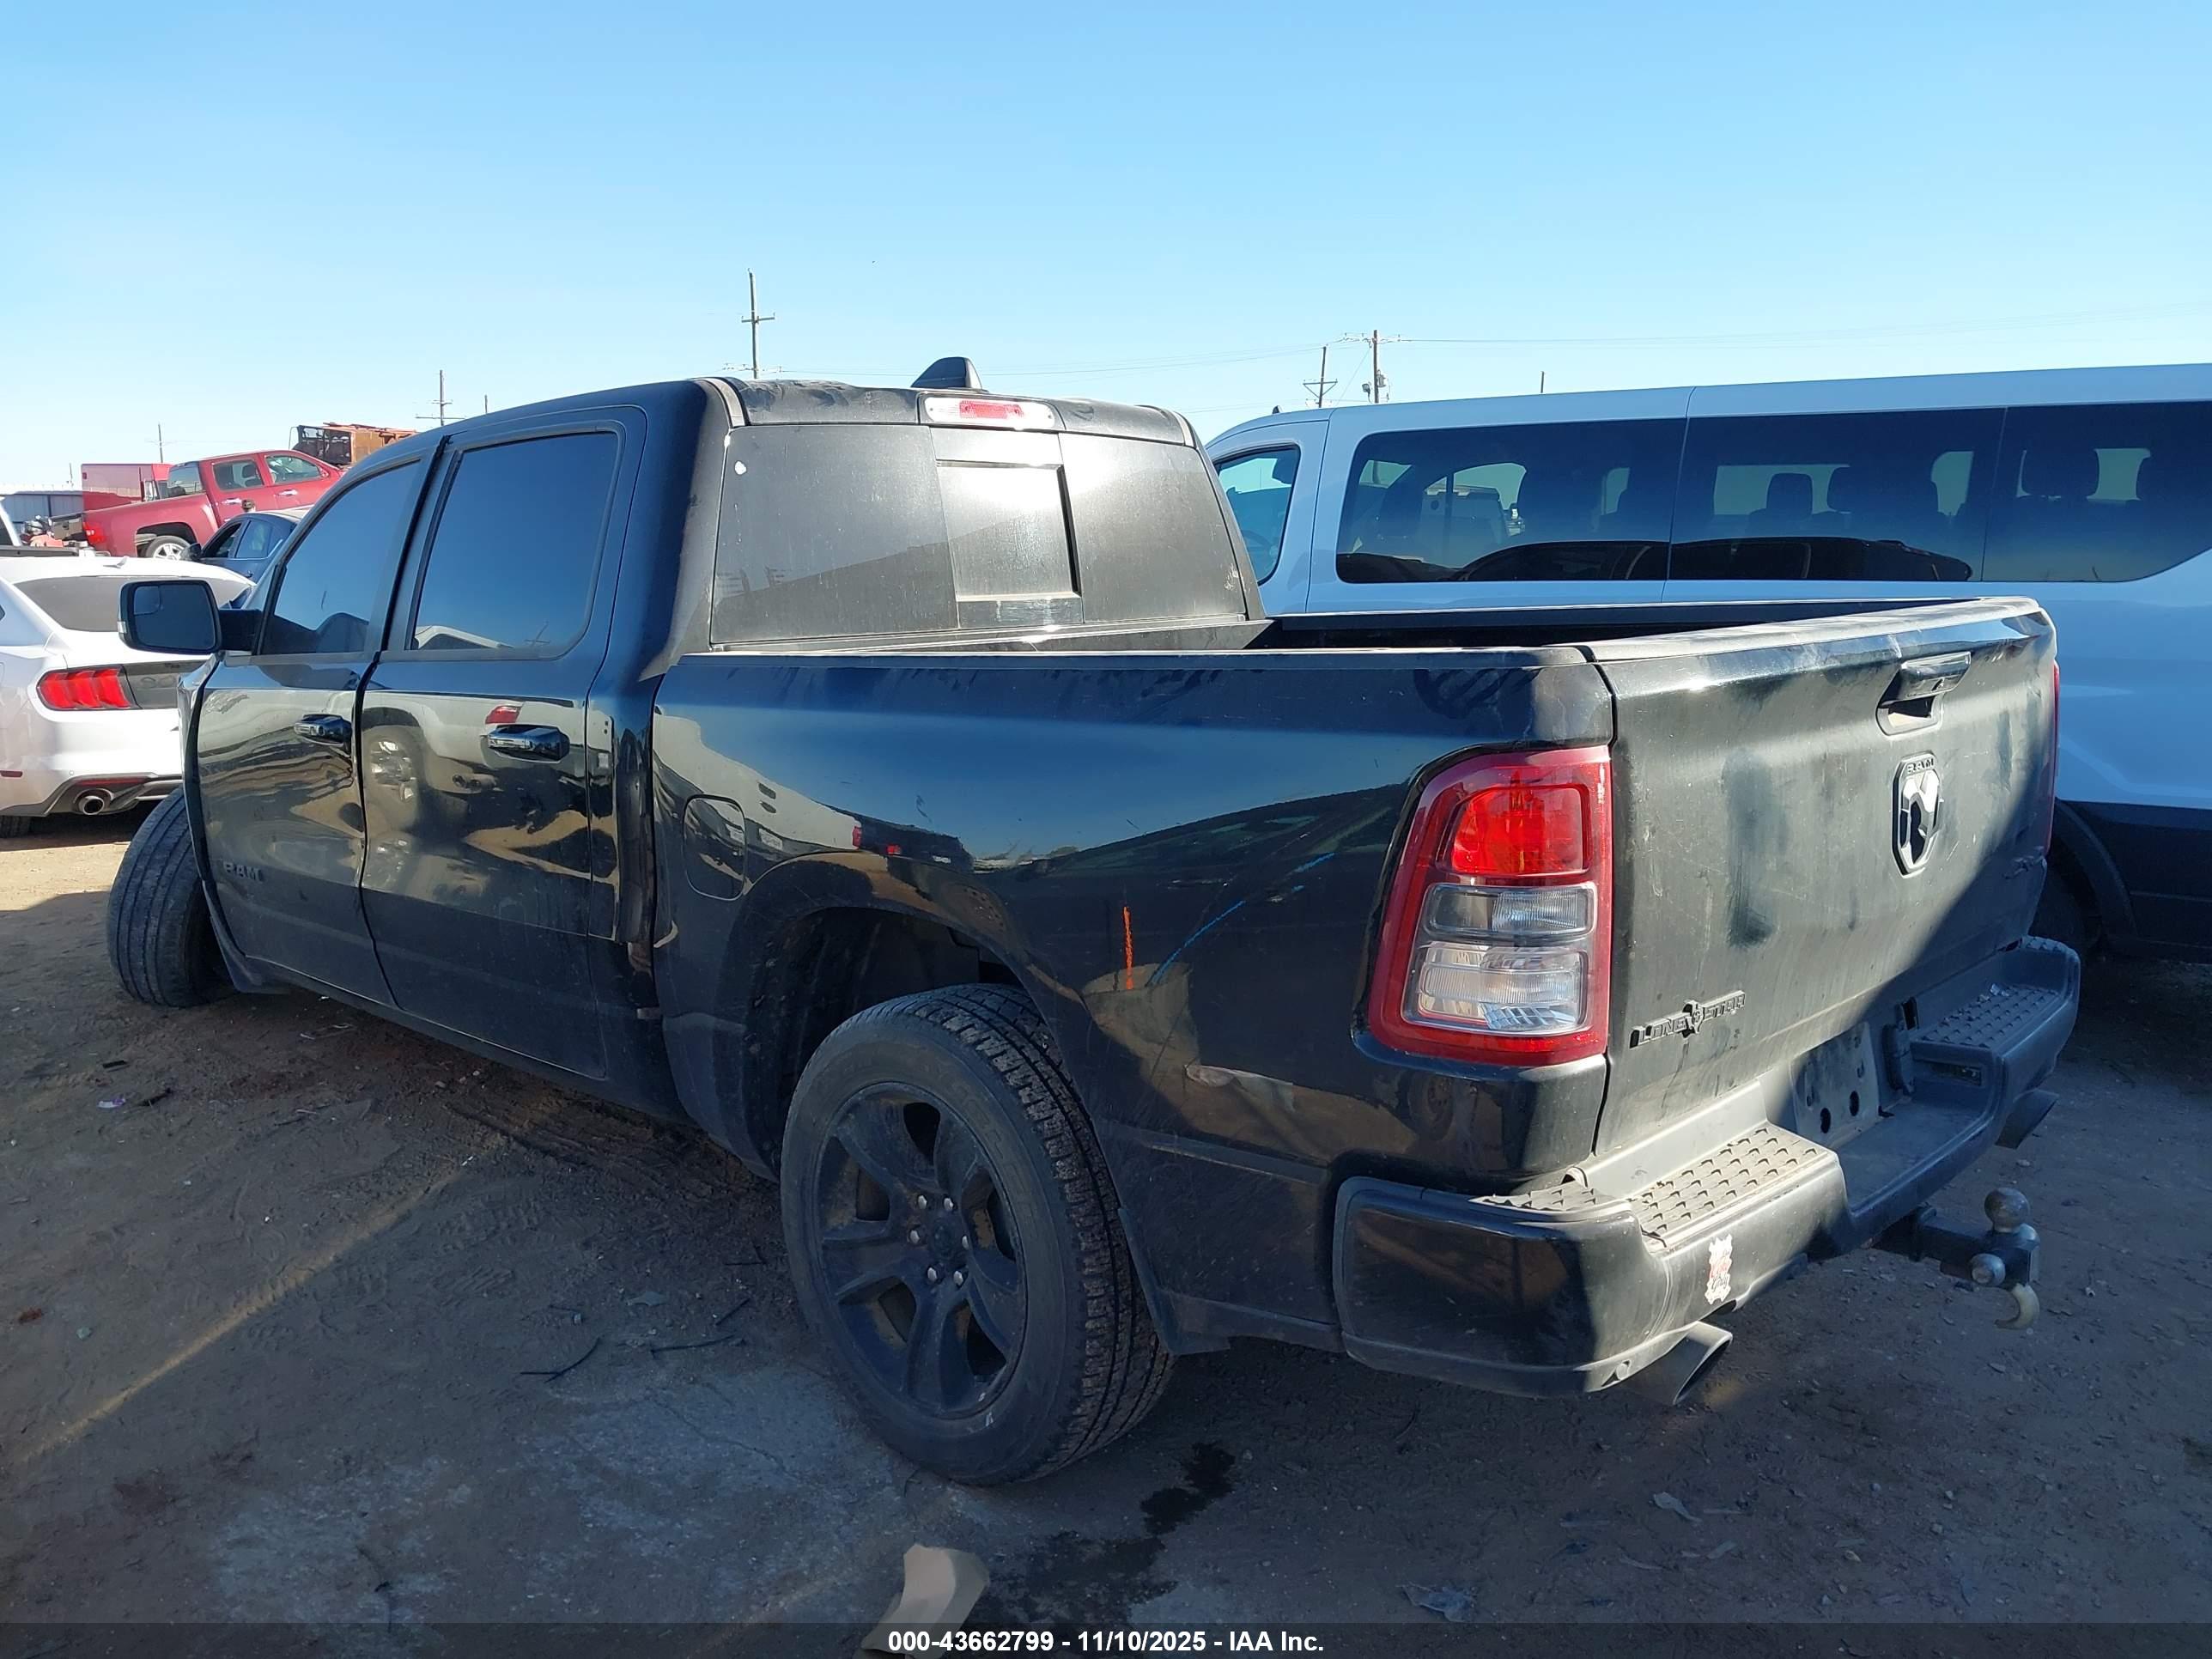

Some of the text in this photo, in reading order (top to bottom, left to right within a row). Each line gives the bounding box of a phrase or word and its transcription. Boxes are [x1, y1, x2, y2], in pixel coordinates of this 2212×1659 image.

[1907, 757, 1935, 773] RAM
[1629, 990, 1747, 1048] LONE STAR
